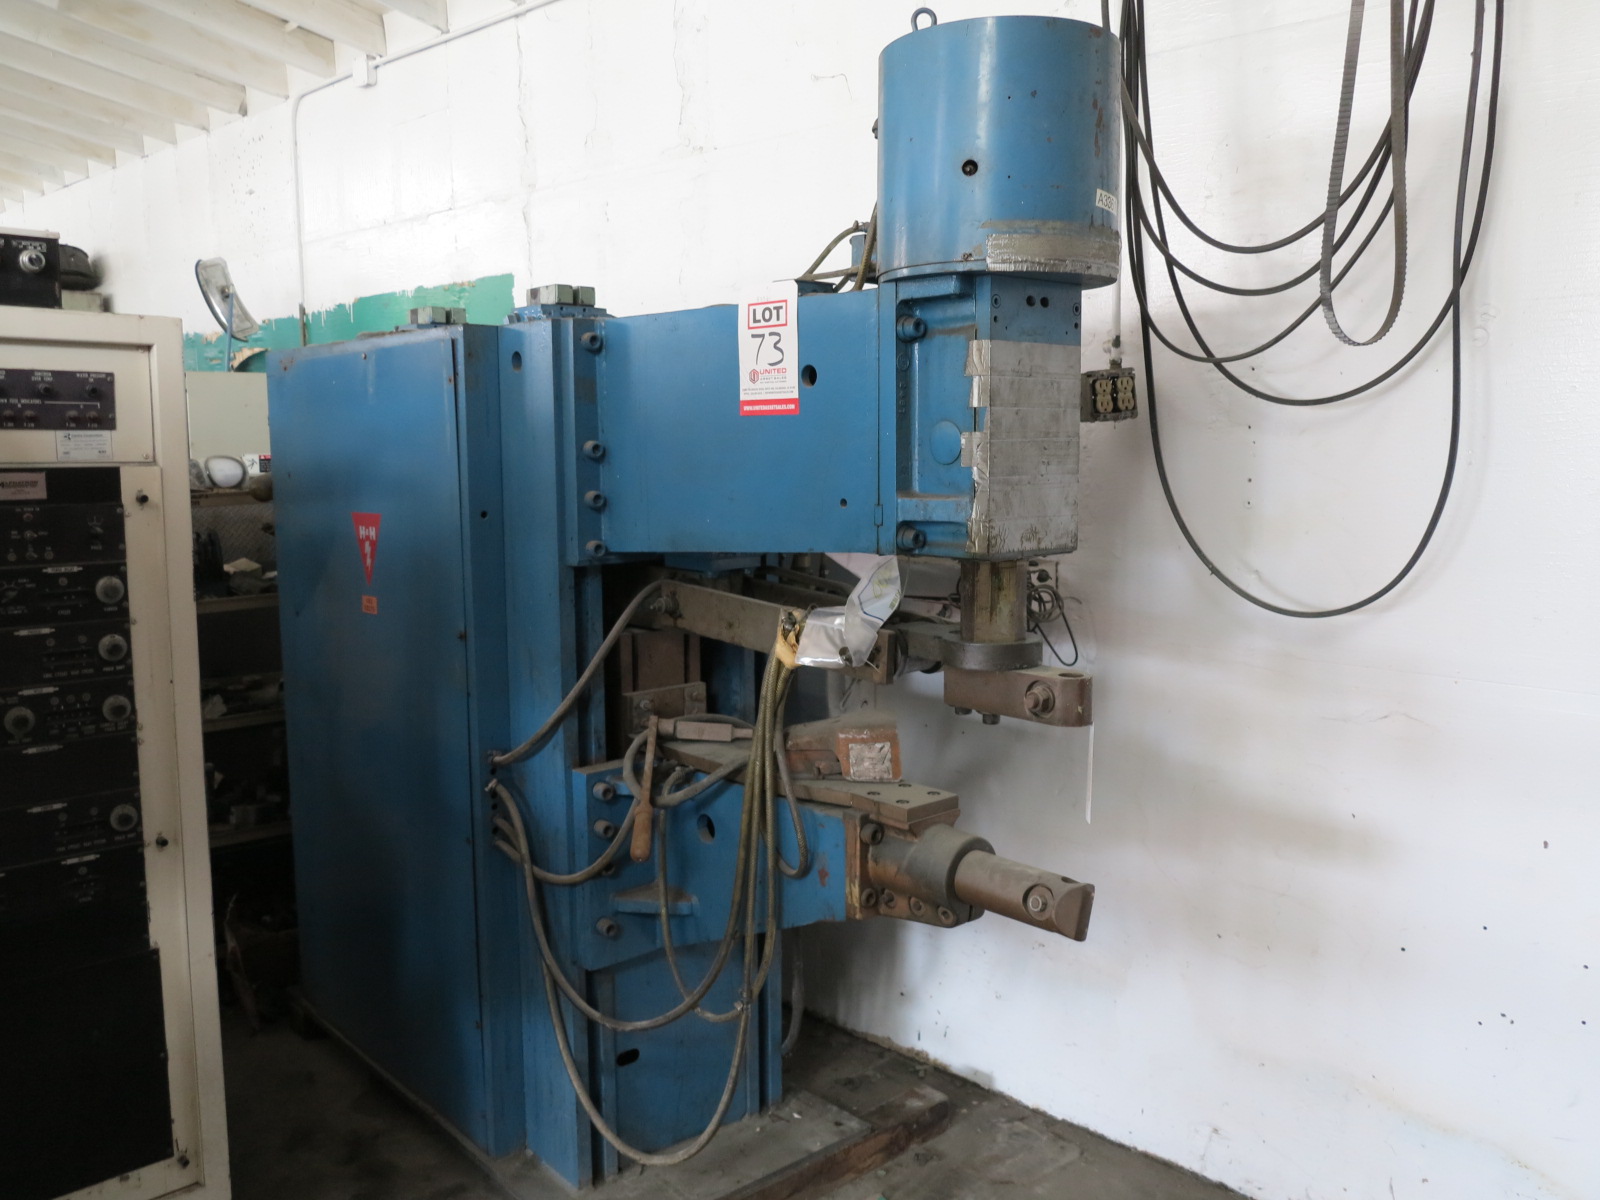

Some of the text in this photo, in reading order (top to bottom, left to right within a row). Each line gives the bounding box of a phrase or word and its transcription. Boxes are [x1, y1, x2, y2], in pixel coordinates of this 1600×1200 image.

[752, 305, 784, 324] LOT
[750, 331, 785, 367] 73
[759, 367, 787, 375] UNITED
